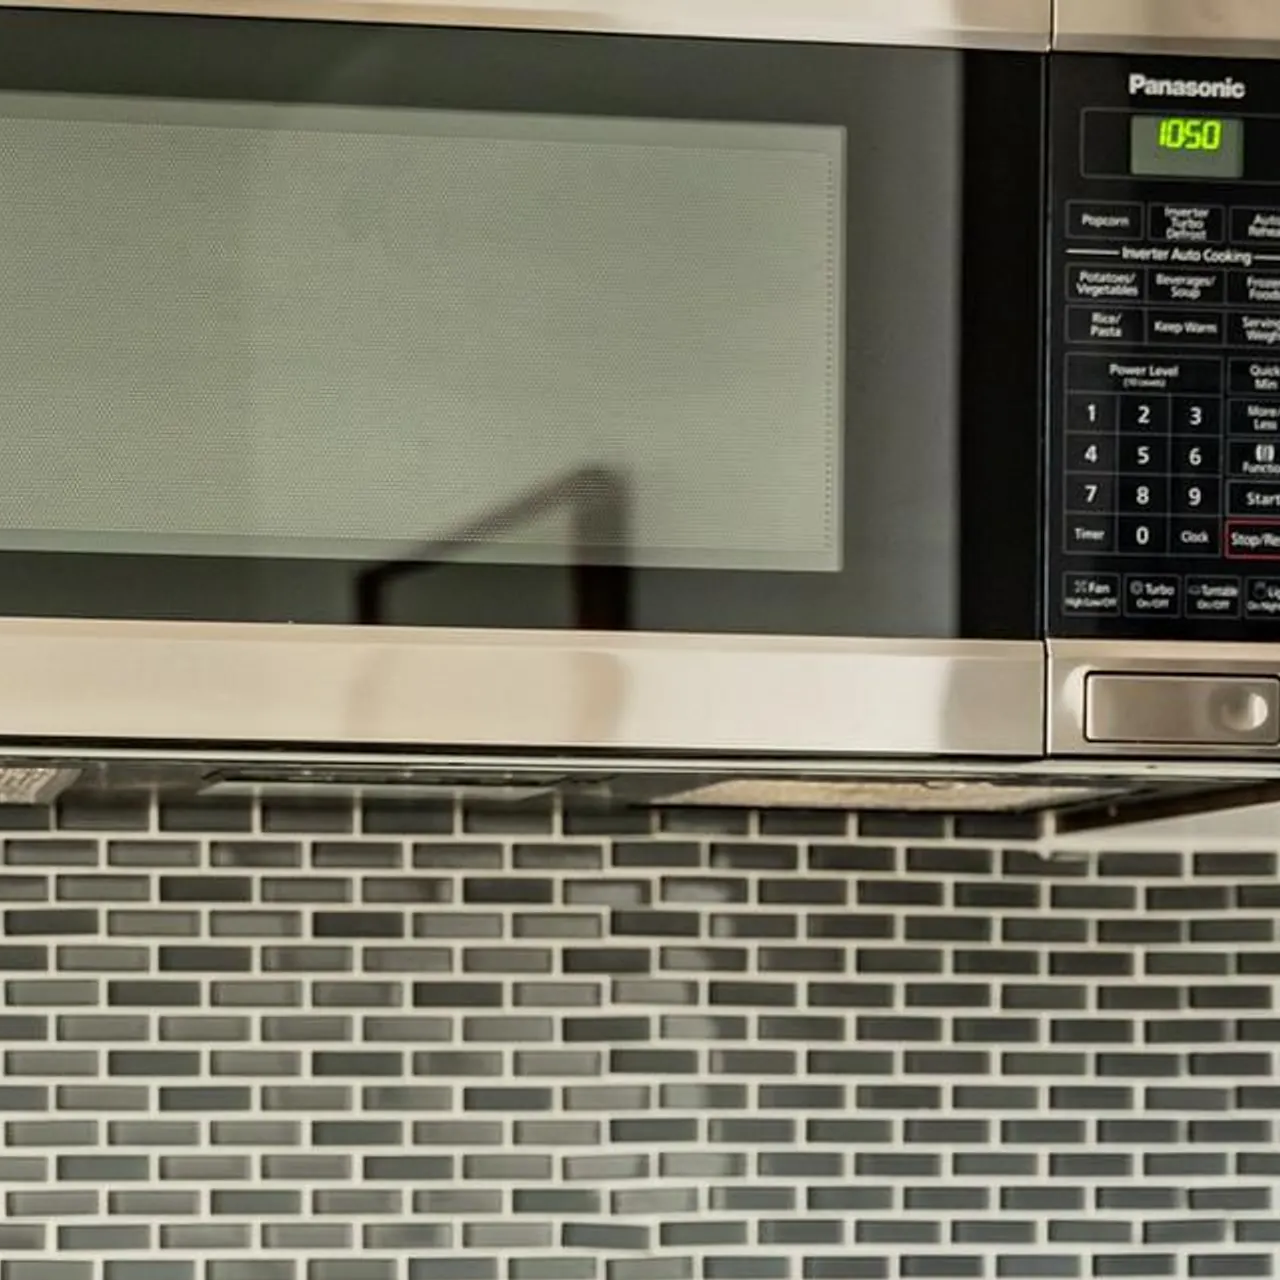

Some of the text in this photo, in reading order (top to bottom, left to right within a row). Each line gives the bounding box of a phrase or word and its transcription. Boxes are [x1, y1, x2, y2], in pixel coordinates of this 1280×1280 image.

[1128, 73, 1246, 99] Panasonic
[1158, 119, 1221, 150] 1050
[1164, 206, 1209, 218] Inverter
[1081, 213, 1130, 228] Popcorn
[1171, 217, 1204, 229] Turbo
[1166, 229, 1207, 241] Defrost
[1122, 247, 1252, 267] Inverter Auto Cooking
[1079, 271, 1136, 284] Potatoes/
[1156, 274, 1216, 287] Beverages/
[1076, 283, 1138, 297] Vegetables
[1170, 286, 1201, 299] Soup
[1091, 313, 1122, 325] Rice/
[1090, 325, 1122, 338] Pasta
[1154, 321, 1217, 334] Keep Warm
[1109, 363, 1179, 377] Power Level
[1249, 364, 1280, 378] Quick
[1087, 404, 1096, 422] 1
[1137, 405, 1150, 424] 2
[1189, 406, 1202, 425] 3
[1253, 418, 1278, 430] Less
[1084, 445, 1097, 463] 4
[1137, 446, 1150, 464] 5
[1189, 447, 1202, 466] 6
[1084, 485, 1098, 503] 7
[1136, 486, 1149, 504] 8
[1188, 487, 1201, 506] 9
[1246, 492, 1280, 506] Start
[1074, 528, 1105, 541] Timer
[1136, 526, 1149, 545] 0
[1180, 530, 1209, 543] Clock
[1088, 582, 1110, 594] Fan
[1145, 583, 1175, 596] Turbo
